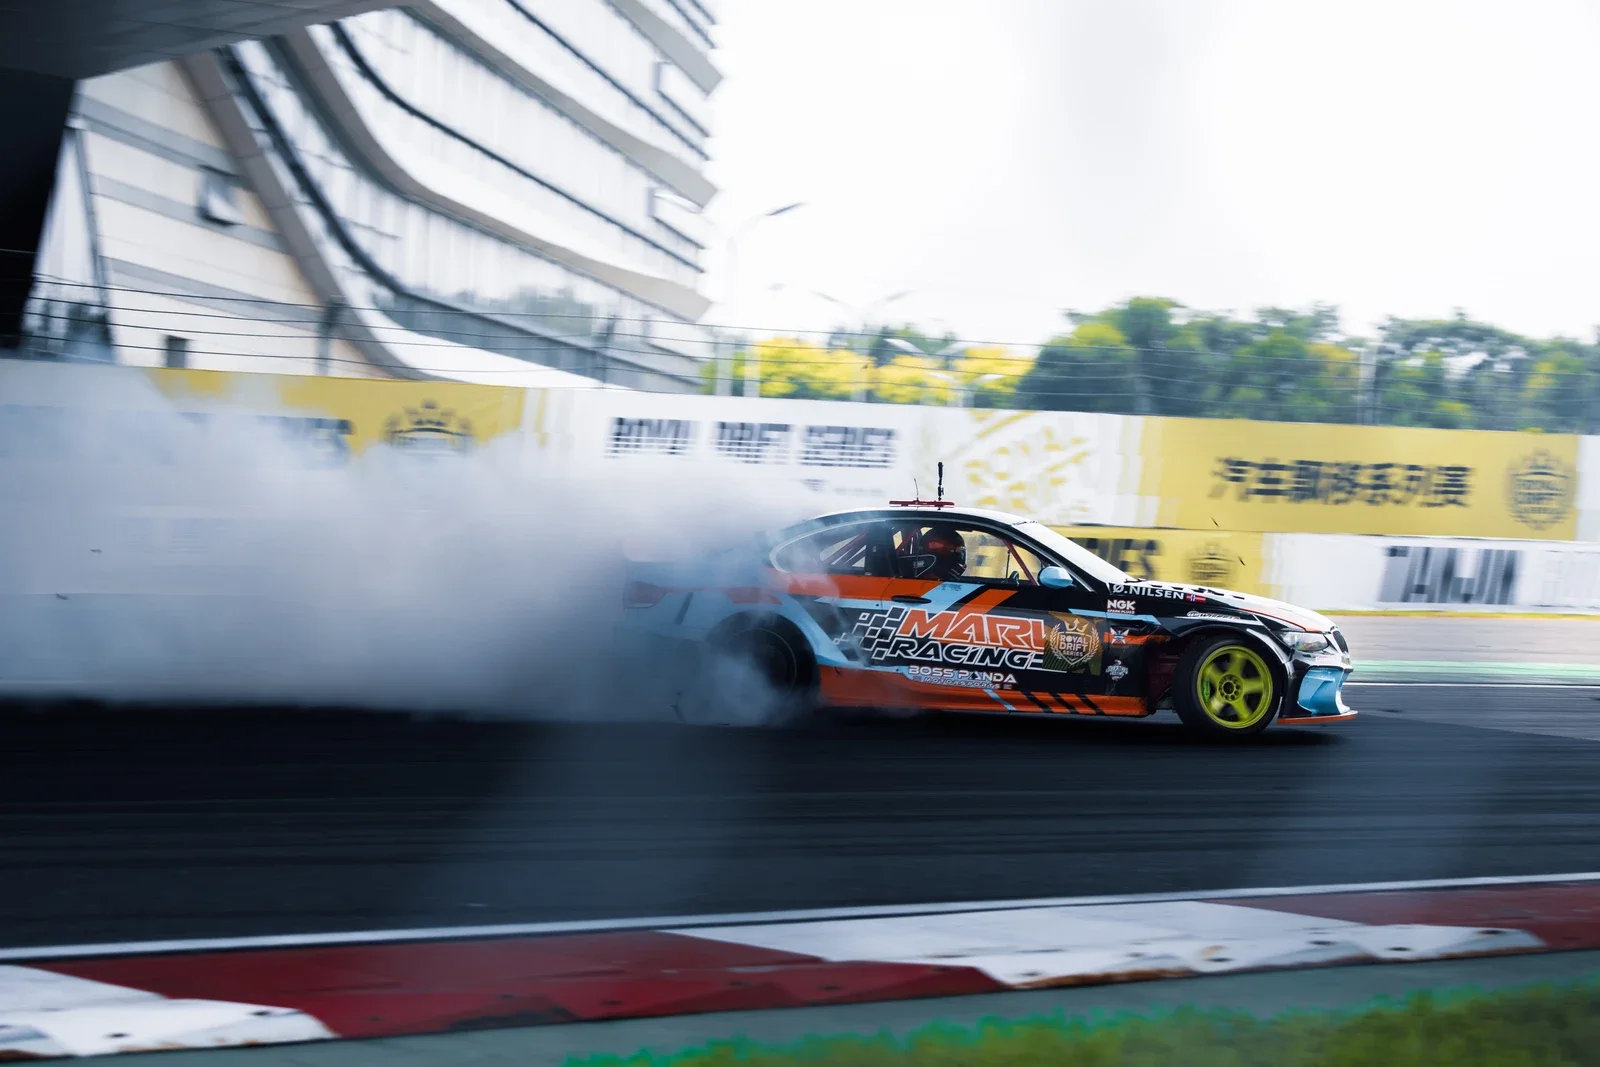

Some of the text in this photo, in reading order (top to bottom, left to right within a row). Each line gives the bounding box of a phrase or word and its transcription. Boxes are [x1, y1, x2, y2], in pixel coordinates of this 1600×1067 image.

[1107, 600, 1136, 610] NGK
[1060, 635, 1088, 645] ROYAL
[1059, 642, 1088, 652] DRIFT
[886, 637, 1035, 670] RACING
[908, 665, 1017, 684] BOSS PANDA
